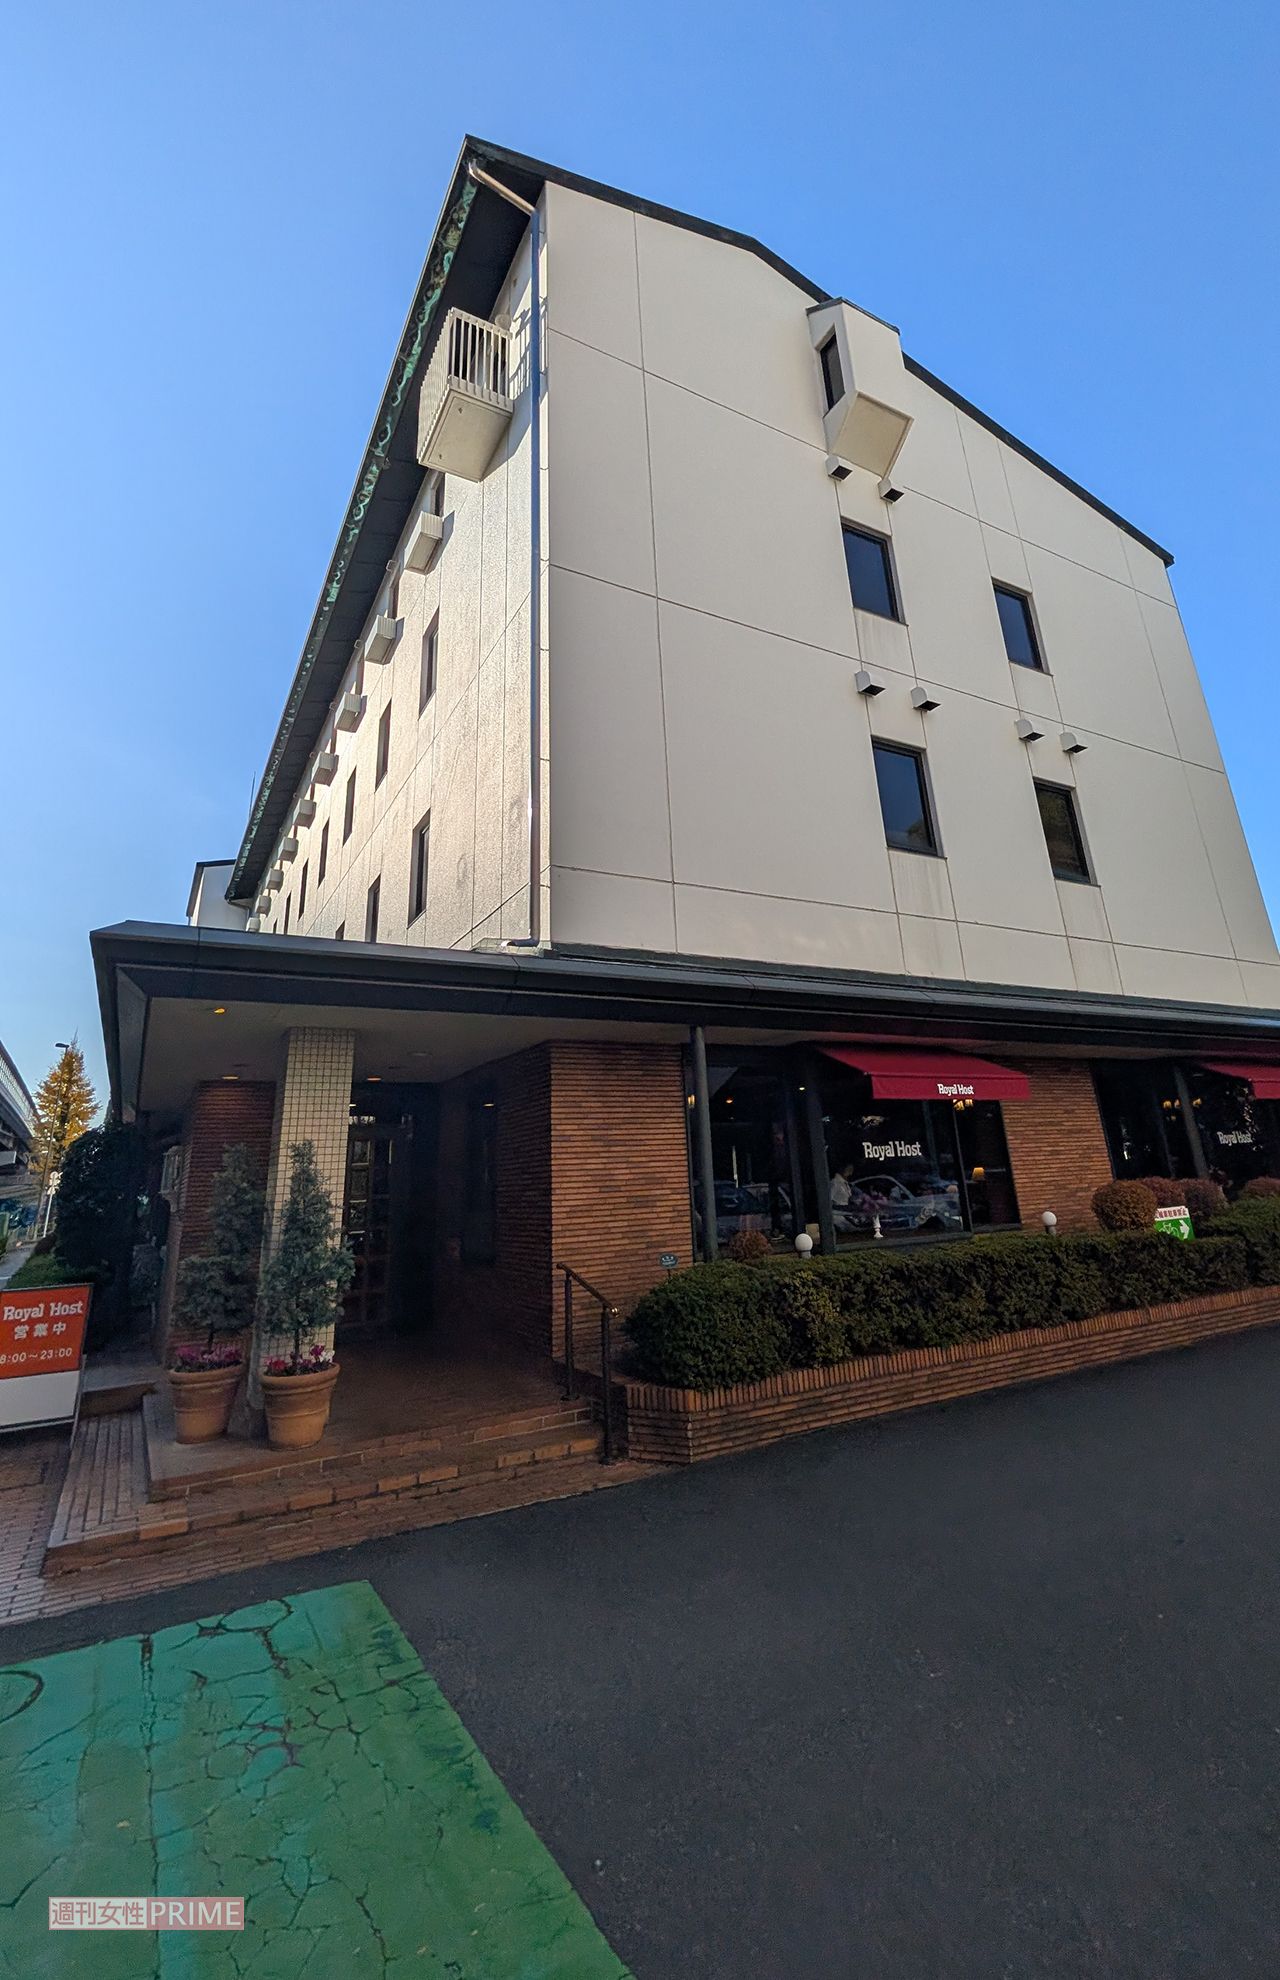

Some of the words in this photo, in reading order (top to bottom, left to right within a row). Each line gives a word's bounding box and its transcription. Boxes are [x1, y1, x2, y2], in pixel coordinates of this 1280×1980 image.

[937, 1083, 957, 1096] Royal
[957, 1084, 974, 1095] Host
[1216, 1131, 1237, 1146] Royal
[862, 1141, 895, 1161] Royal
[895, 1141, 922, 1156] Host
[3, 1303, 45, 1322] Royal
[49, 1300, 83, 1316] Host
[14, 1321, 67, 1340] 営業中
